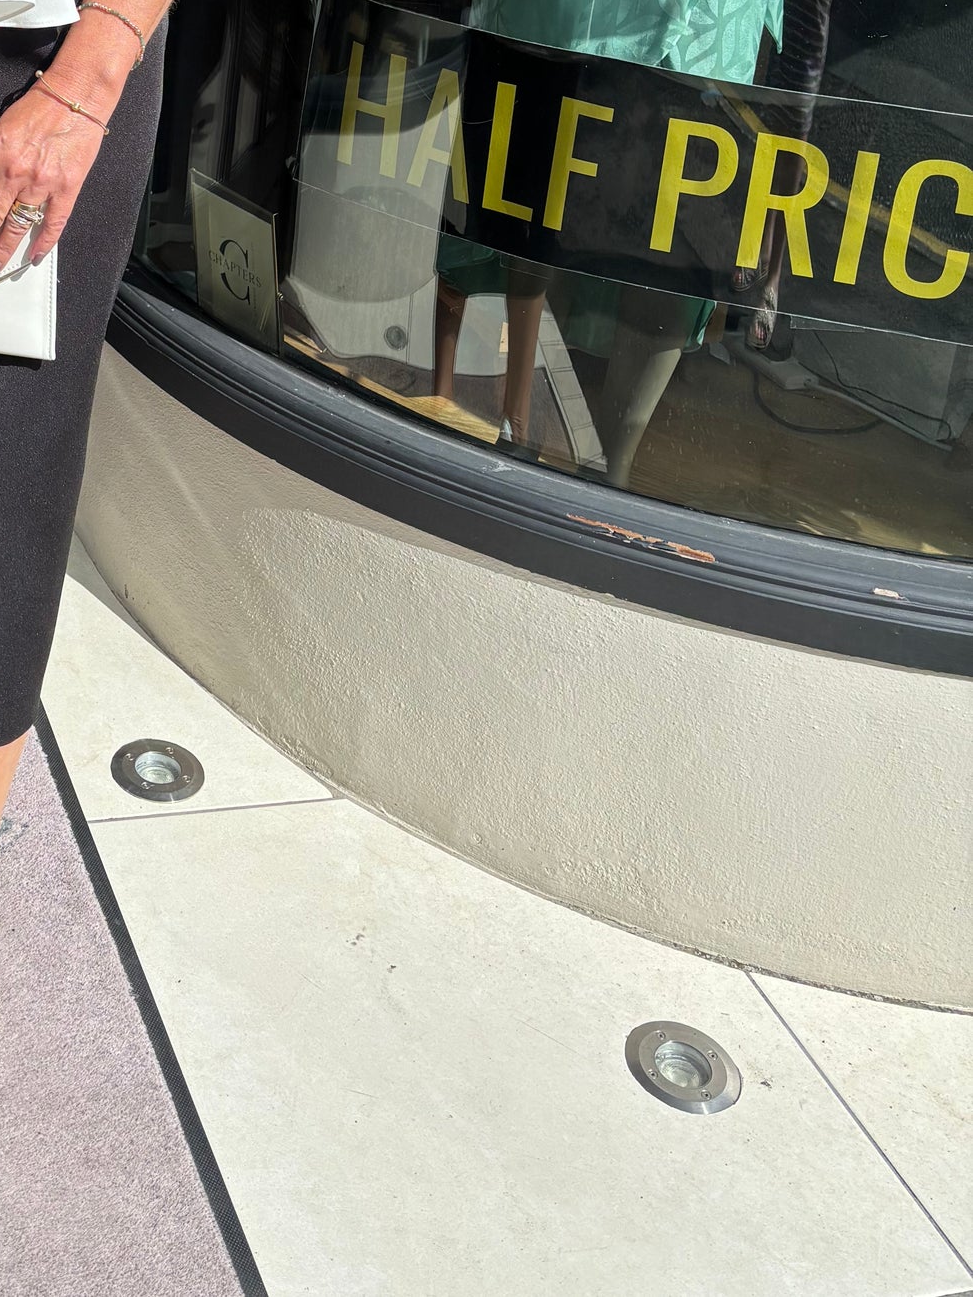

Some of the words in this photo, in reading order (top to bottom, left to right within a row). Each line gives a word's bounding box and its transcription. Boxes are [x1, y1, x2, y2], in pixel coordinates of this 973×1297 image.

[336, 41, 615, 232] HALF
[649, 117, 973, 300] PRIC
[208, 249, 262, 288] CHAPTERS
